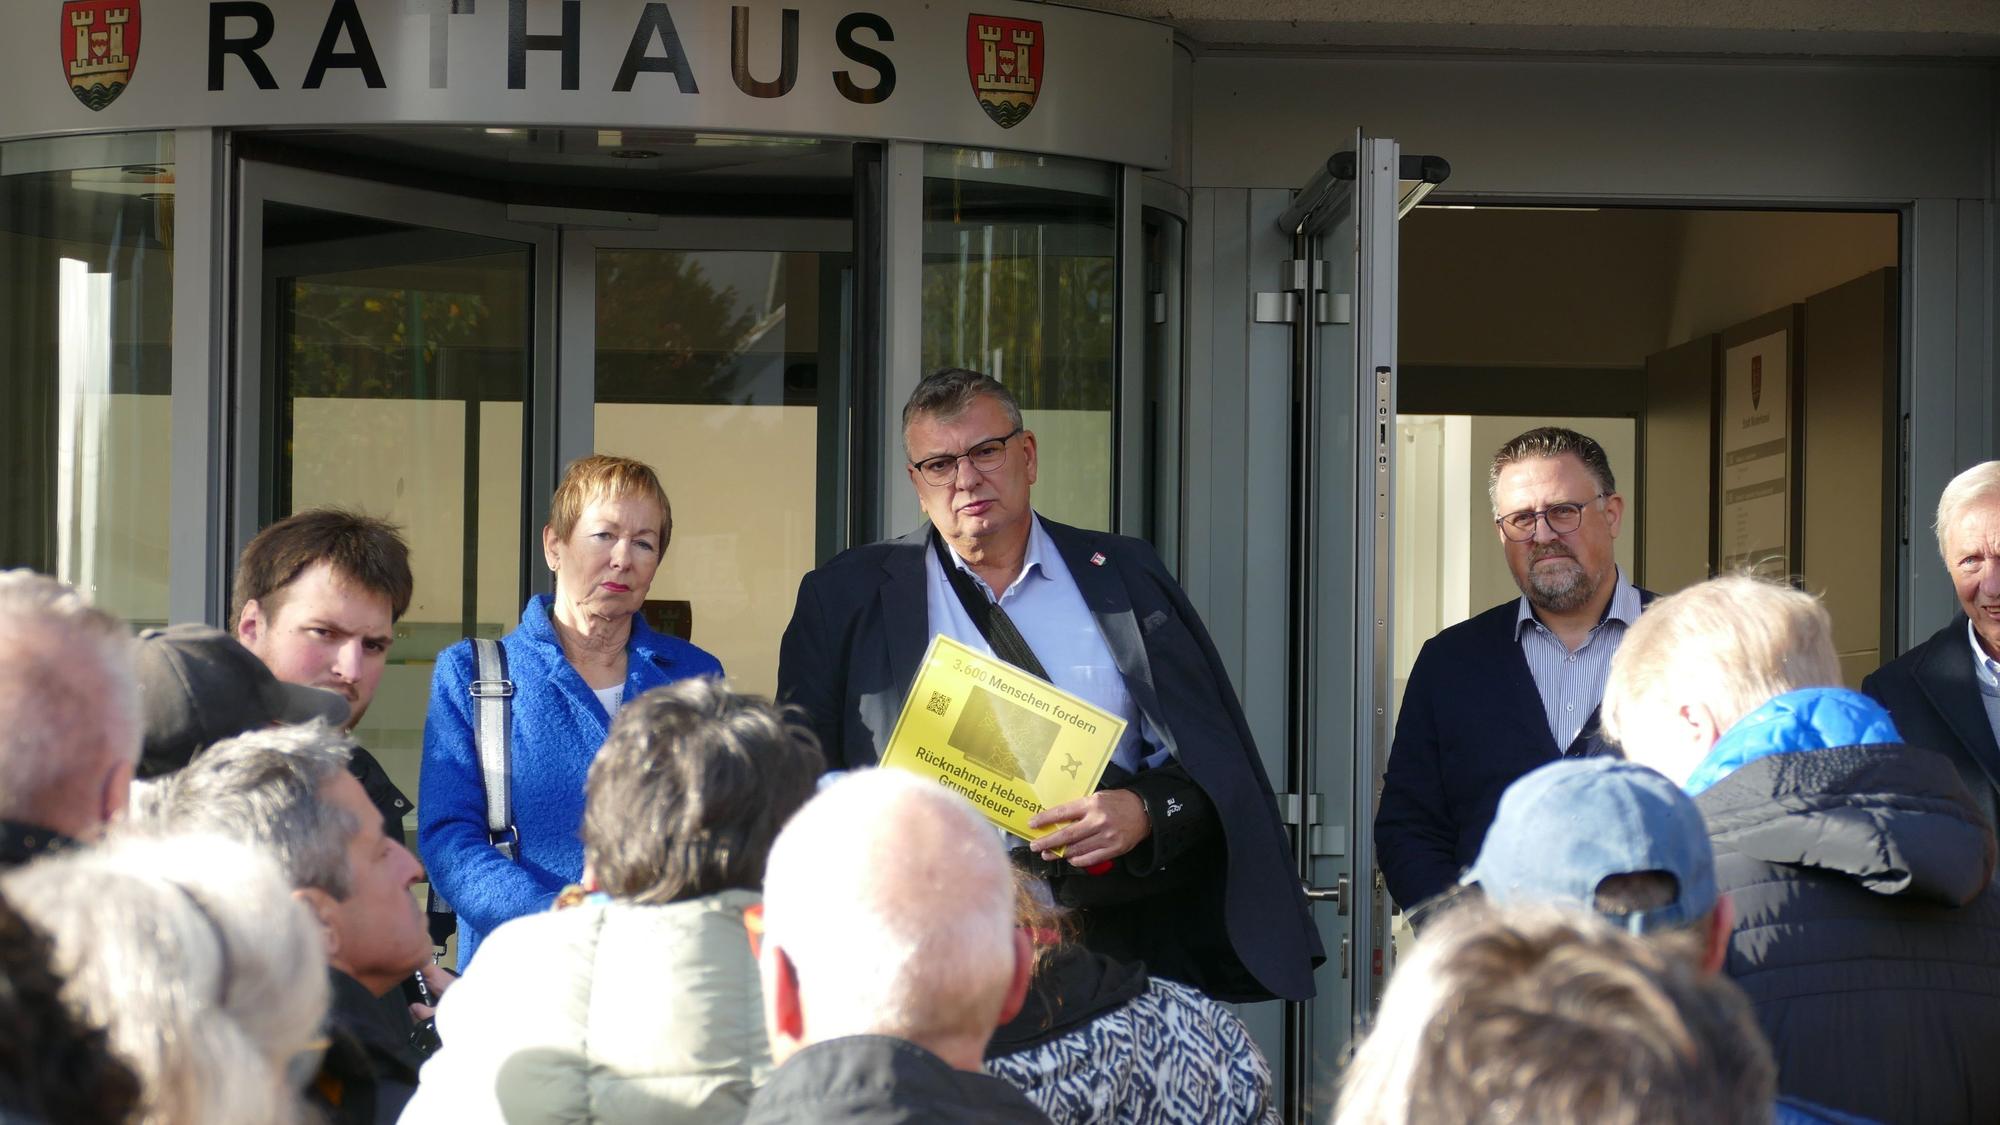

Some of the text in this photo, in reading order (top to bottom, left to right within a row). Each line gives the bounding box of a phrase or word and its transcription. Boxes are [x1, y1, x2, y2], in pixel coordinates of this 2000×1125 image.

[207, 0, 897, 104] RATHAUS
[952, 658, 1097, 735] 3.600 Menschen fordern
[915, 746, 989, 789] Rücknahme
[938, 774, 1016, 818] Grundsteuer
